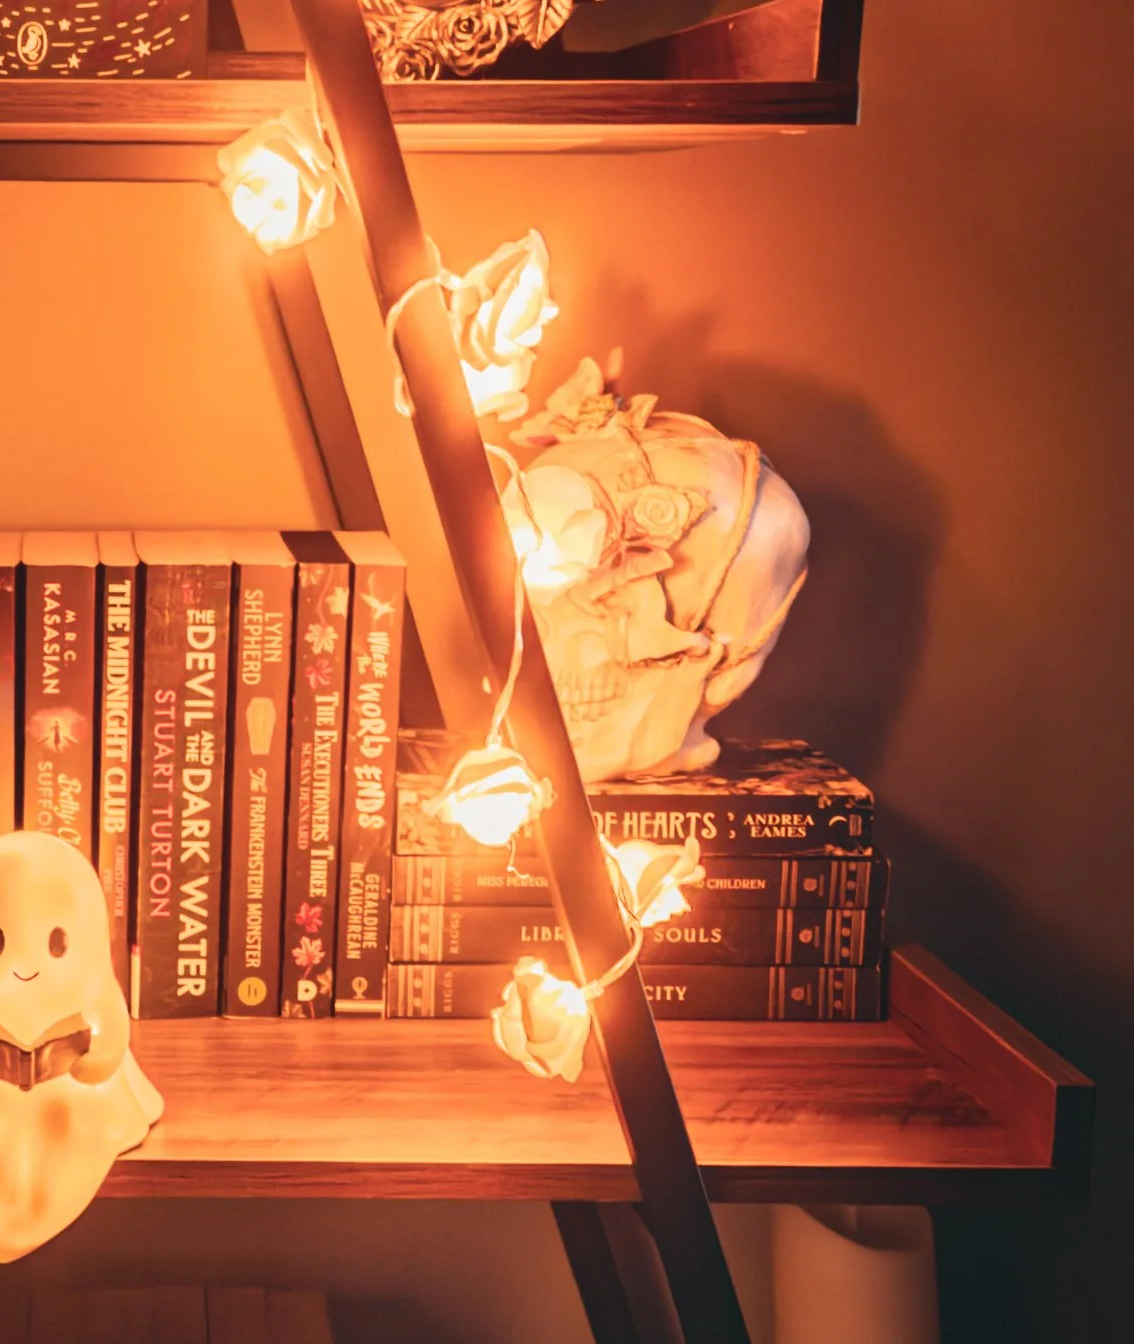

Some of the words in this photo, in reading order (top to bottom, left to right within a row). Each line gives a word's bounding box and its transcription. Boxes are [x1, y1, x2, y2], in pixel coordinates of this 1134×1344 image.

[107, 579, 131, 631] THE
[186, 609, 216, 625] THE
[42, 583, 62, 694] KASASIAN
[241, 589, 263, 685] SHEPHERD
[263, 612, 282, 662] LYNN
[357, 651, 370, 675] the
[105, 636, 130, 760] MIDNIGHT
[184, 625, 215, 728] DEVIL
[152, 689, 176, 793] STUART
[357, 683, 391, 758] WORLD
[185, 734, 201, 763] THE
[200, 730, 214, 765] AND
[299, 742, 313, 783] SUSAN
[37, 760, 53, 832] SUFFO
[52, 773, 82, 825] Betty
[104, 766, 127, 833] CLUB
[248, 767, 268, 794] The
[354, 765, 387, 829] ENDS
[180, 768, 211, 864] DARK
[297, 786, 310, 850] DENNARD
[622, 812, 717, 840] HEARTS
[744, 814, 815, 826] ANDREA
[751, 826, 807, 838] EAMES
[149, 804, 174, 917] TURTON
[247, 796, 266, 899] FRANKENSTEIN
[114, 844, 126, 917] CHRISTOPHER
[476, 876, 505, 888] MISS
[707, 879, 766, 890] CHILDREN
[177, 876, 209, 997] WATER
[245, 903, 263, 968] MONSTER
[361, 874, 380, 948] GERALDINE
[450, 913, 461, 954] RIGGS
[521, 926, 565, 941] LIBR
[653, 927, 722, 944] SOULS
[443, 971, 453, 1012] RIGGS
[643, 986, 687, 1001] CITY
